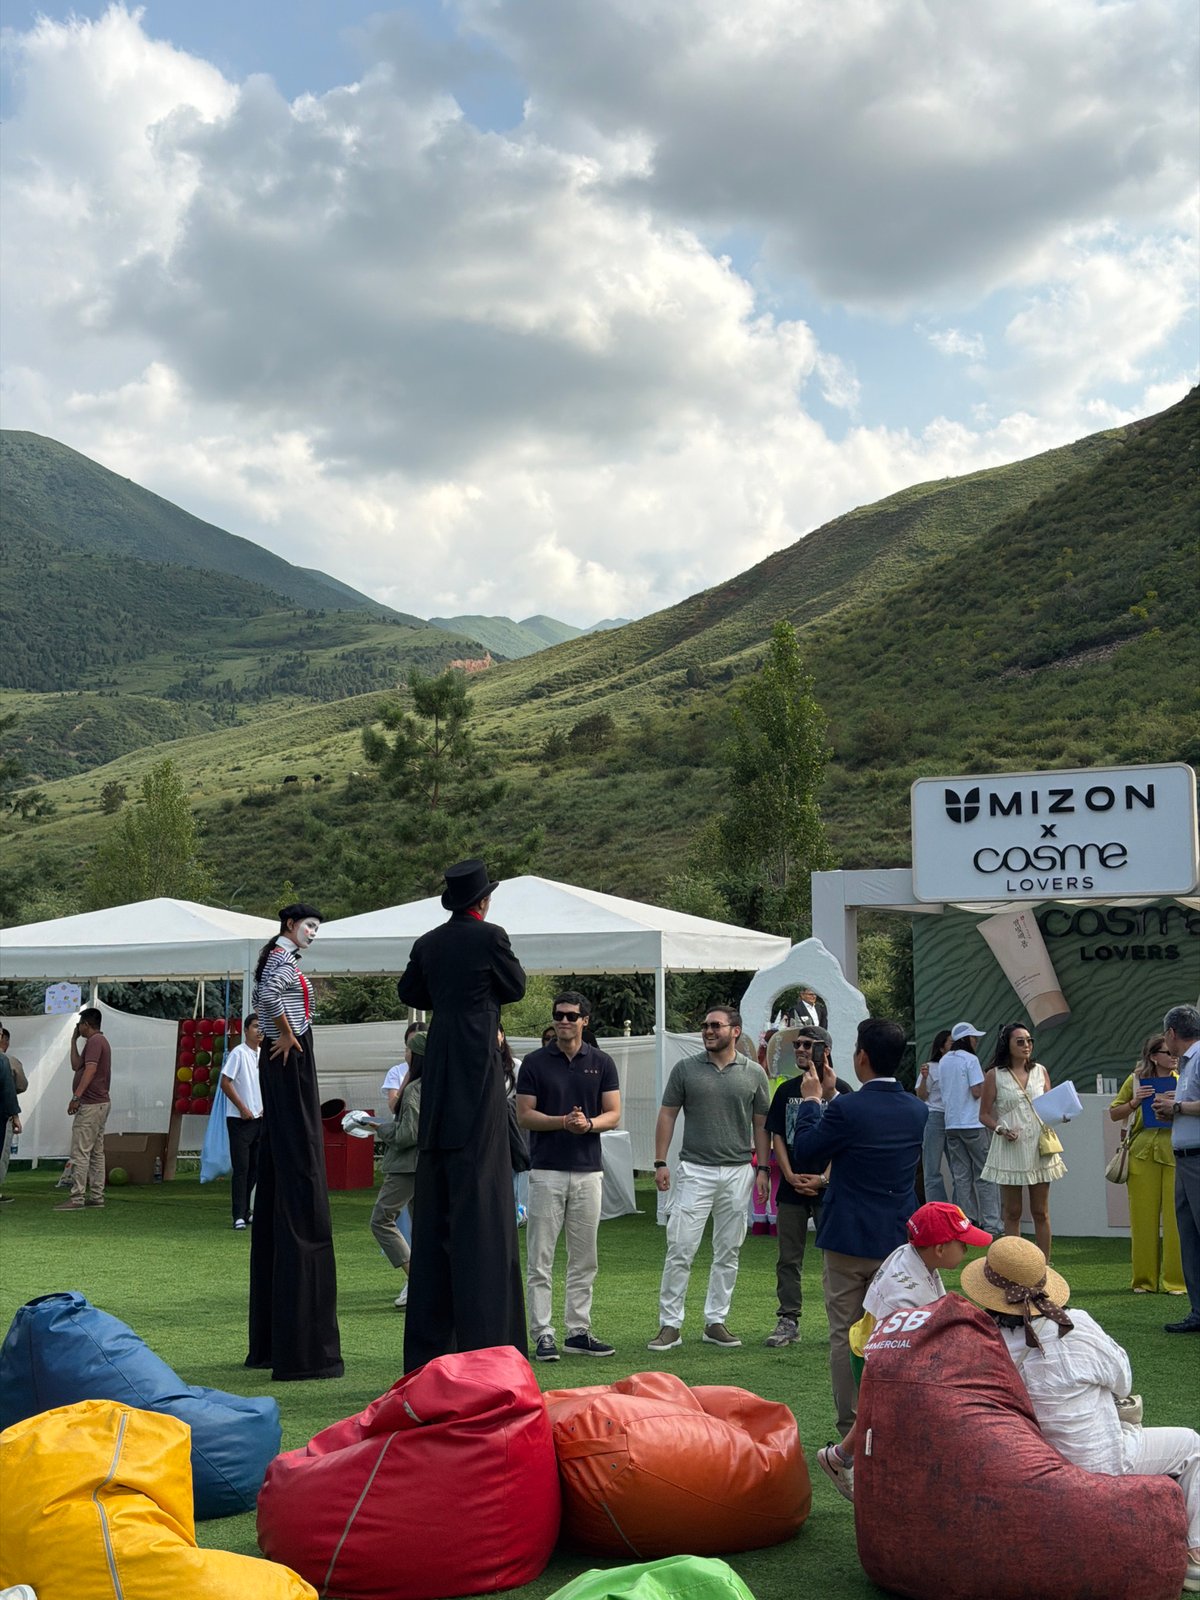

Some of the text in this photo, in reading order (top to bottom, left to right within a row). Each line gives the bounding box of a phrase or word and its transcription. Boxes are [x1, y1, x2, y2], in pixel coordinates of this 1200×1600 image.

[989, 784, 1155, 817] MIZON
[973, 842, 1128, 873] cosme
[1007, 876, 1094, 892] LOVERS
[1080, 944, 1181, 961] LOVERS
